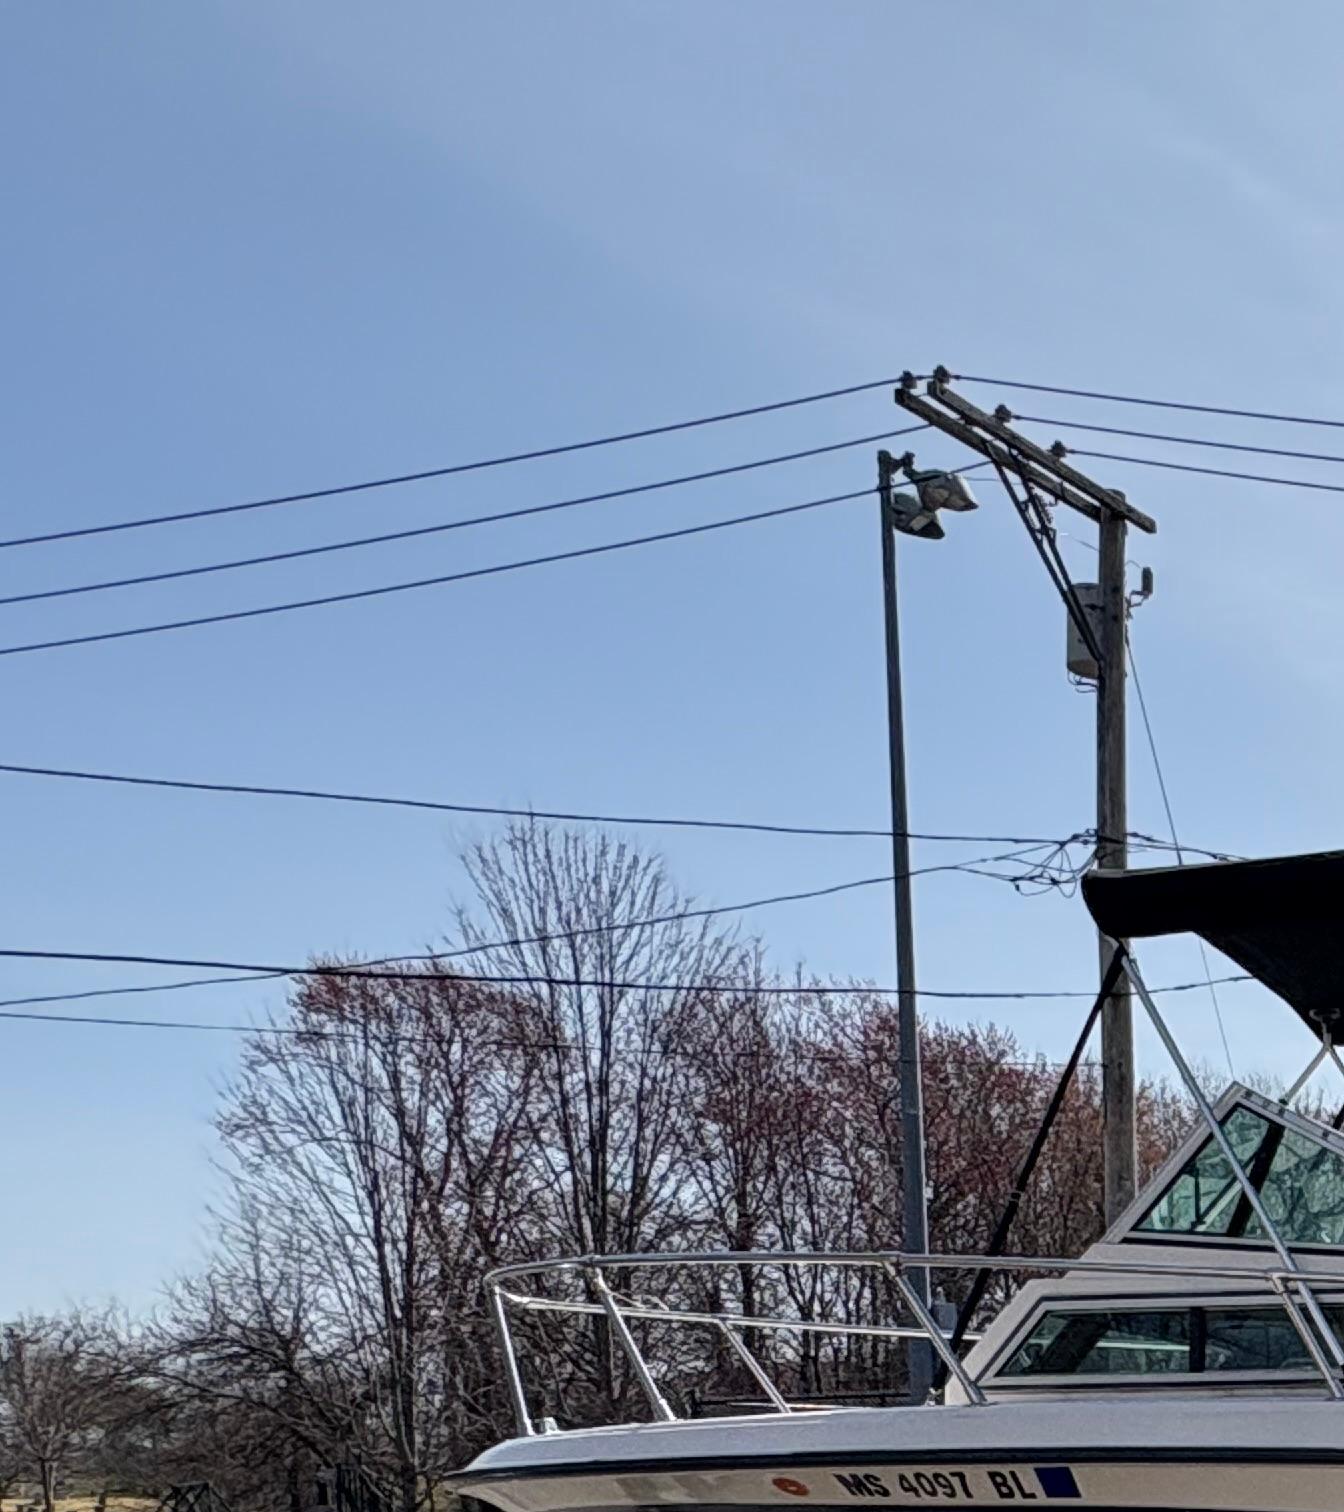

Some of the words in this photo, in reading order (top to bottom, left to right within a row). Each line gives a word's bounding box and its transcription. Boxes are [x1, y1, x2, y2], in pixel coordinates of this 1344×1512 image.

[834, 1473, 892, 1498] MS
[899, 1472, 974, 1498] 4097
[987, 1470, 1037, 1499] BL
